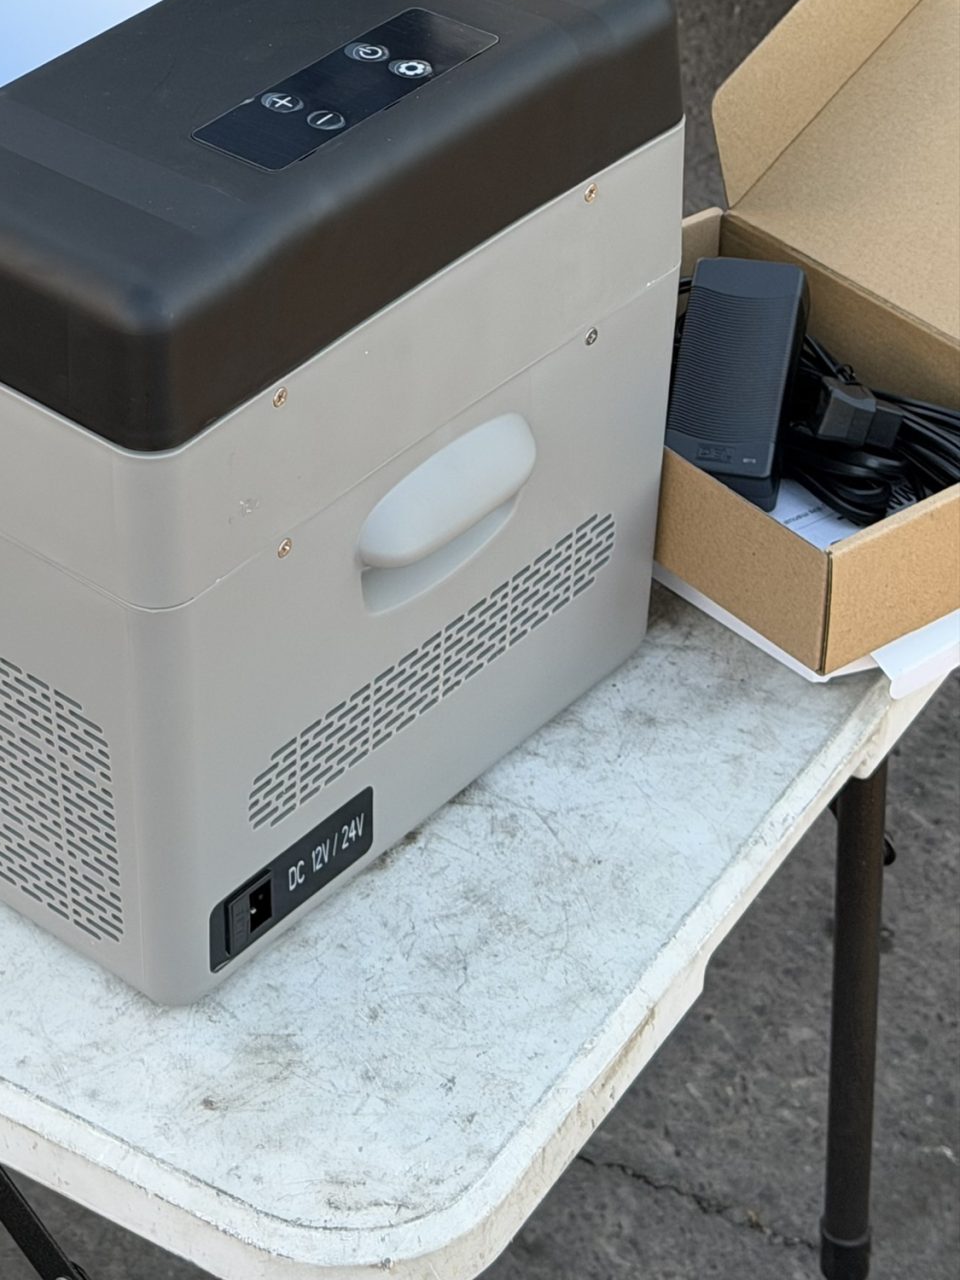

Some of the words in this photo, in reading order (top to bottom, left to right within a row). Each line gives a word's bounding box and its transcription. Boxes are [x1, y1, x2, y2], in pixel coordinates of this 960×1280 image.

[288, 859, 306, 891] DC
[311, 838, 330, 873] 12V
[332, 832, 338, 857] /
[341, 812, 365, 850] 24V
